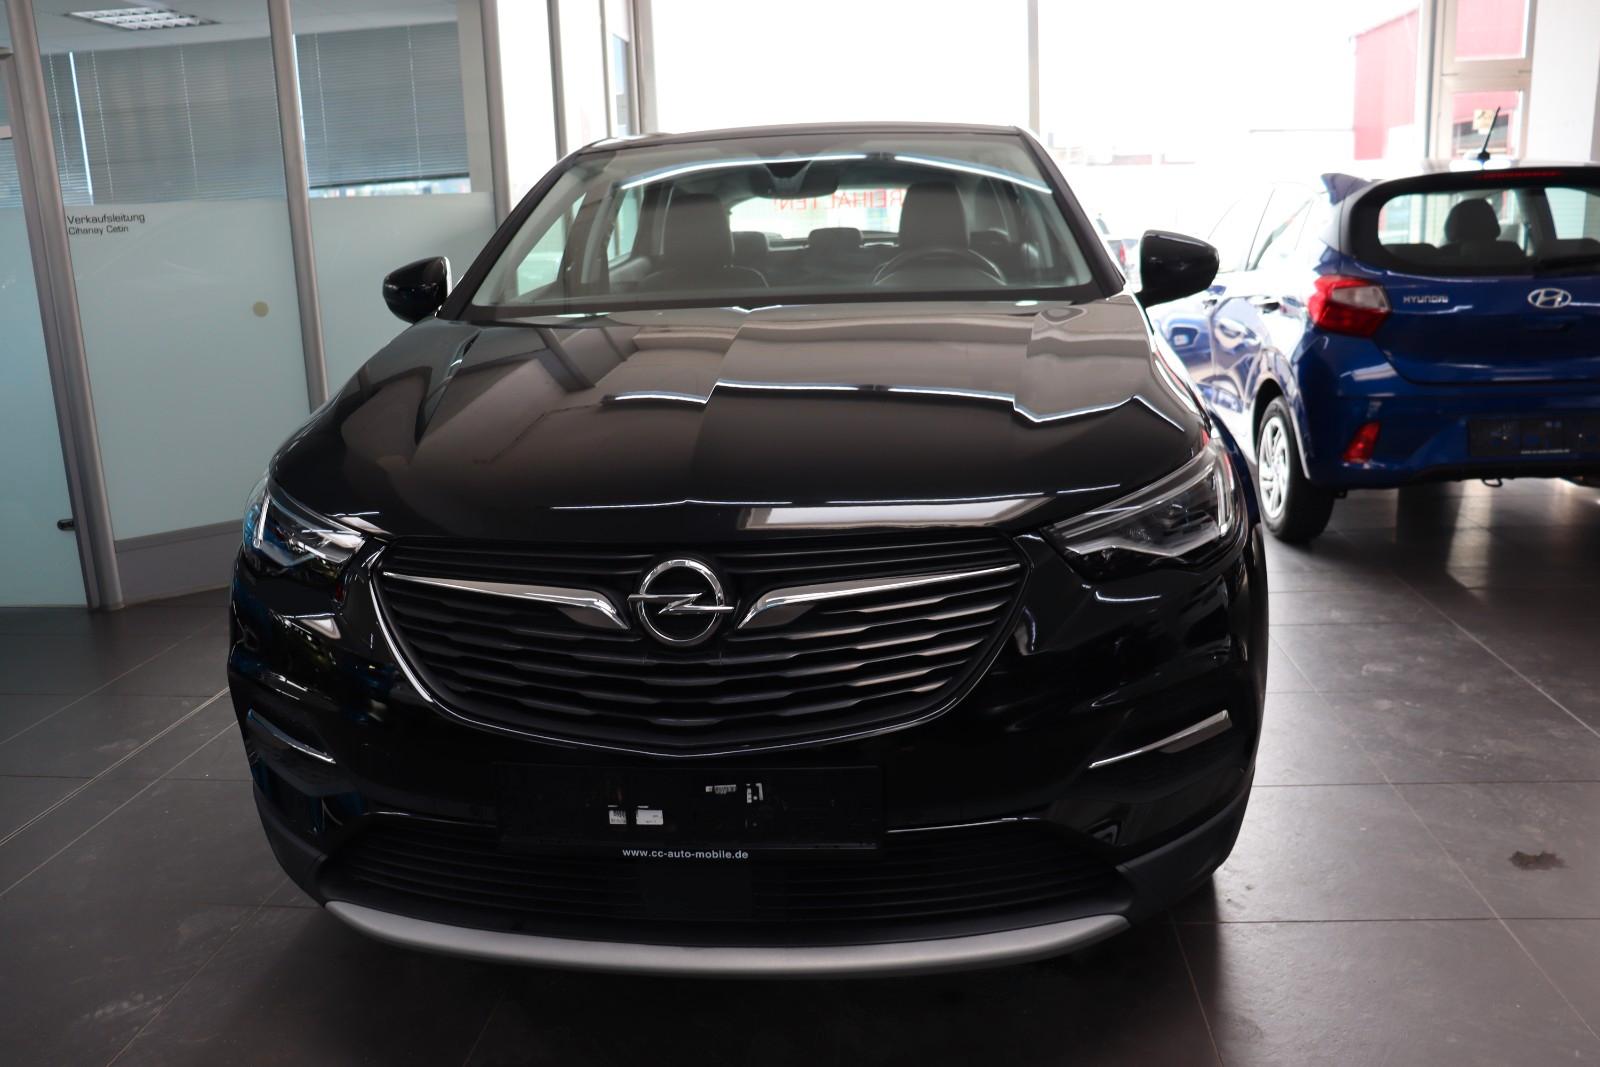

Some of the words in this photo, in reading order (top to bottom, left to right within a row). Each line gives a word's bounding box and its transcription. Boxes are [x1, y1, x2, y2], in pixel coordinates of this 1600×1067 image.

[66, 213, 146, 224] Verkaufsleitung
[1403, 295, 1449, 304] HYUNDAI
[622, 849, 749, 859] www.cc-auto-mobile.de
